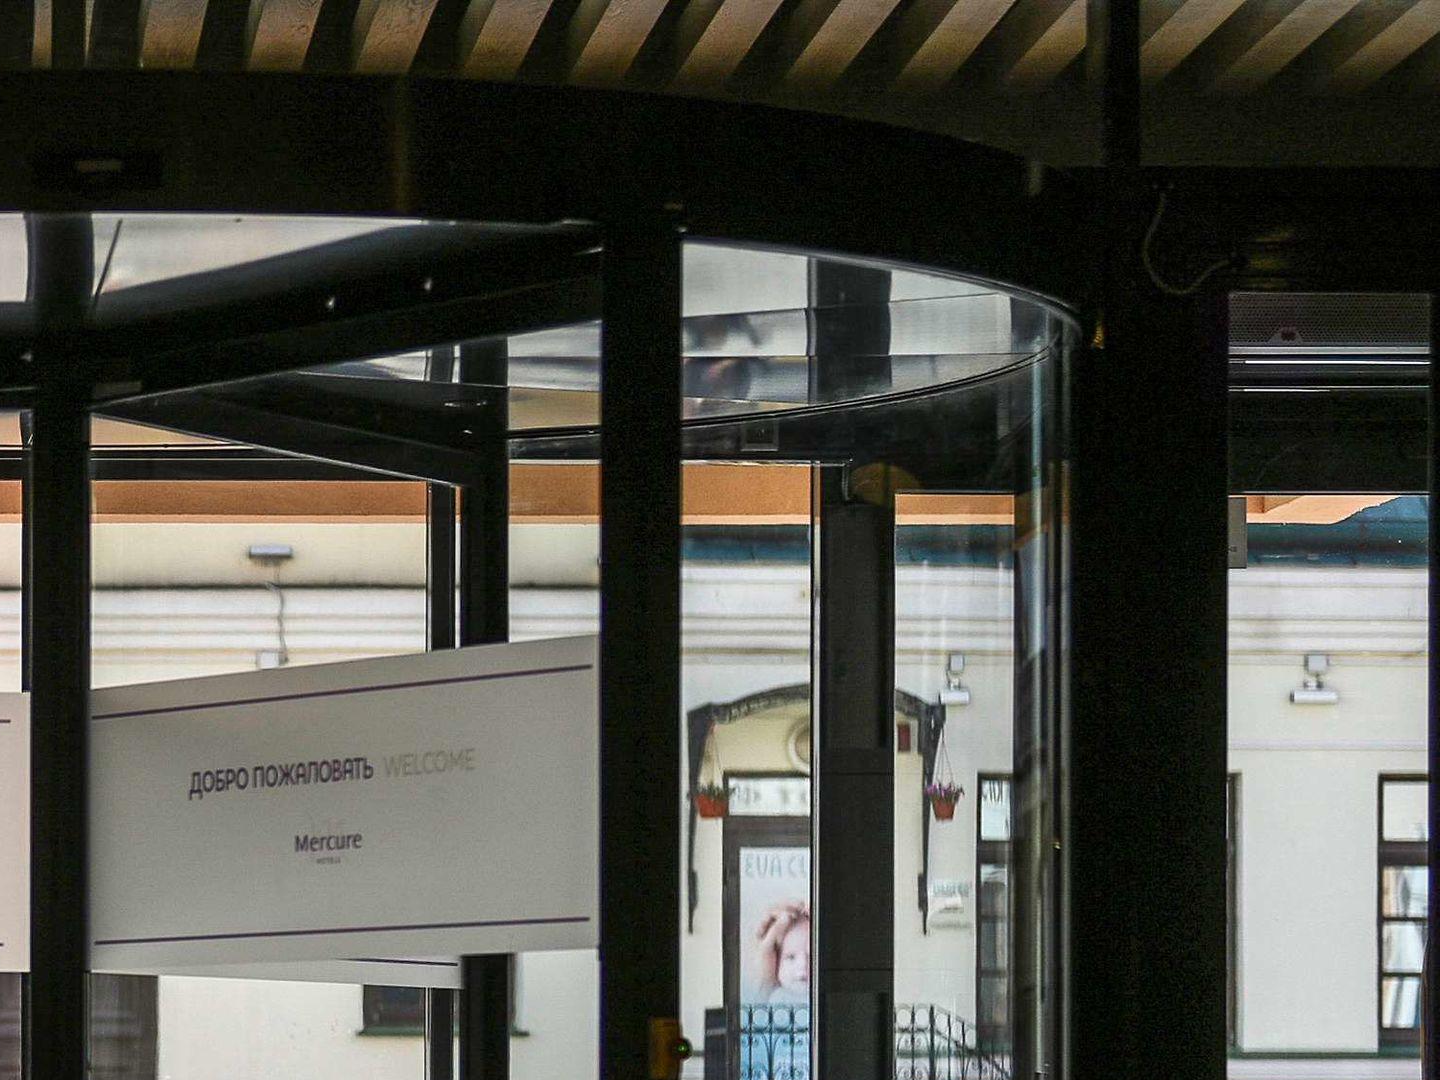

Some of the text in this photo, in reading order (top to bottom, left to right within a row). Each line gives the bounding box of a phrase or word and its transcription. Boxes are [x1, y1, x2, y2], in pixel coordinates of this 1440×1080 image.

[189, 748, 477, 800] ДОБРО ПОЖАЛОВАТЬ WELCOME
[294, 833, 363, 853] Mercure
